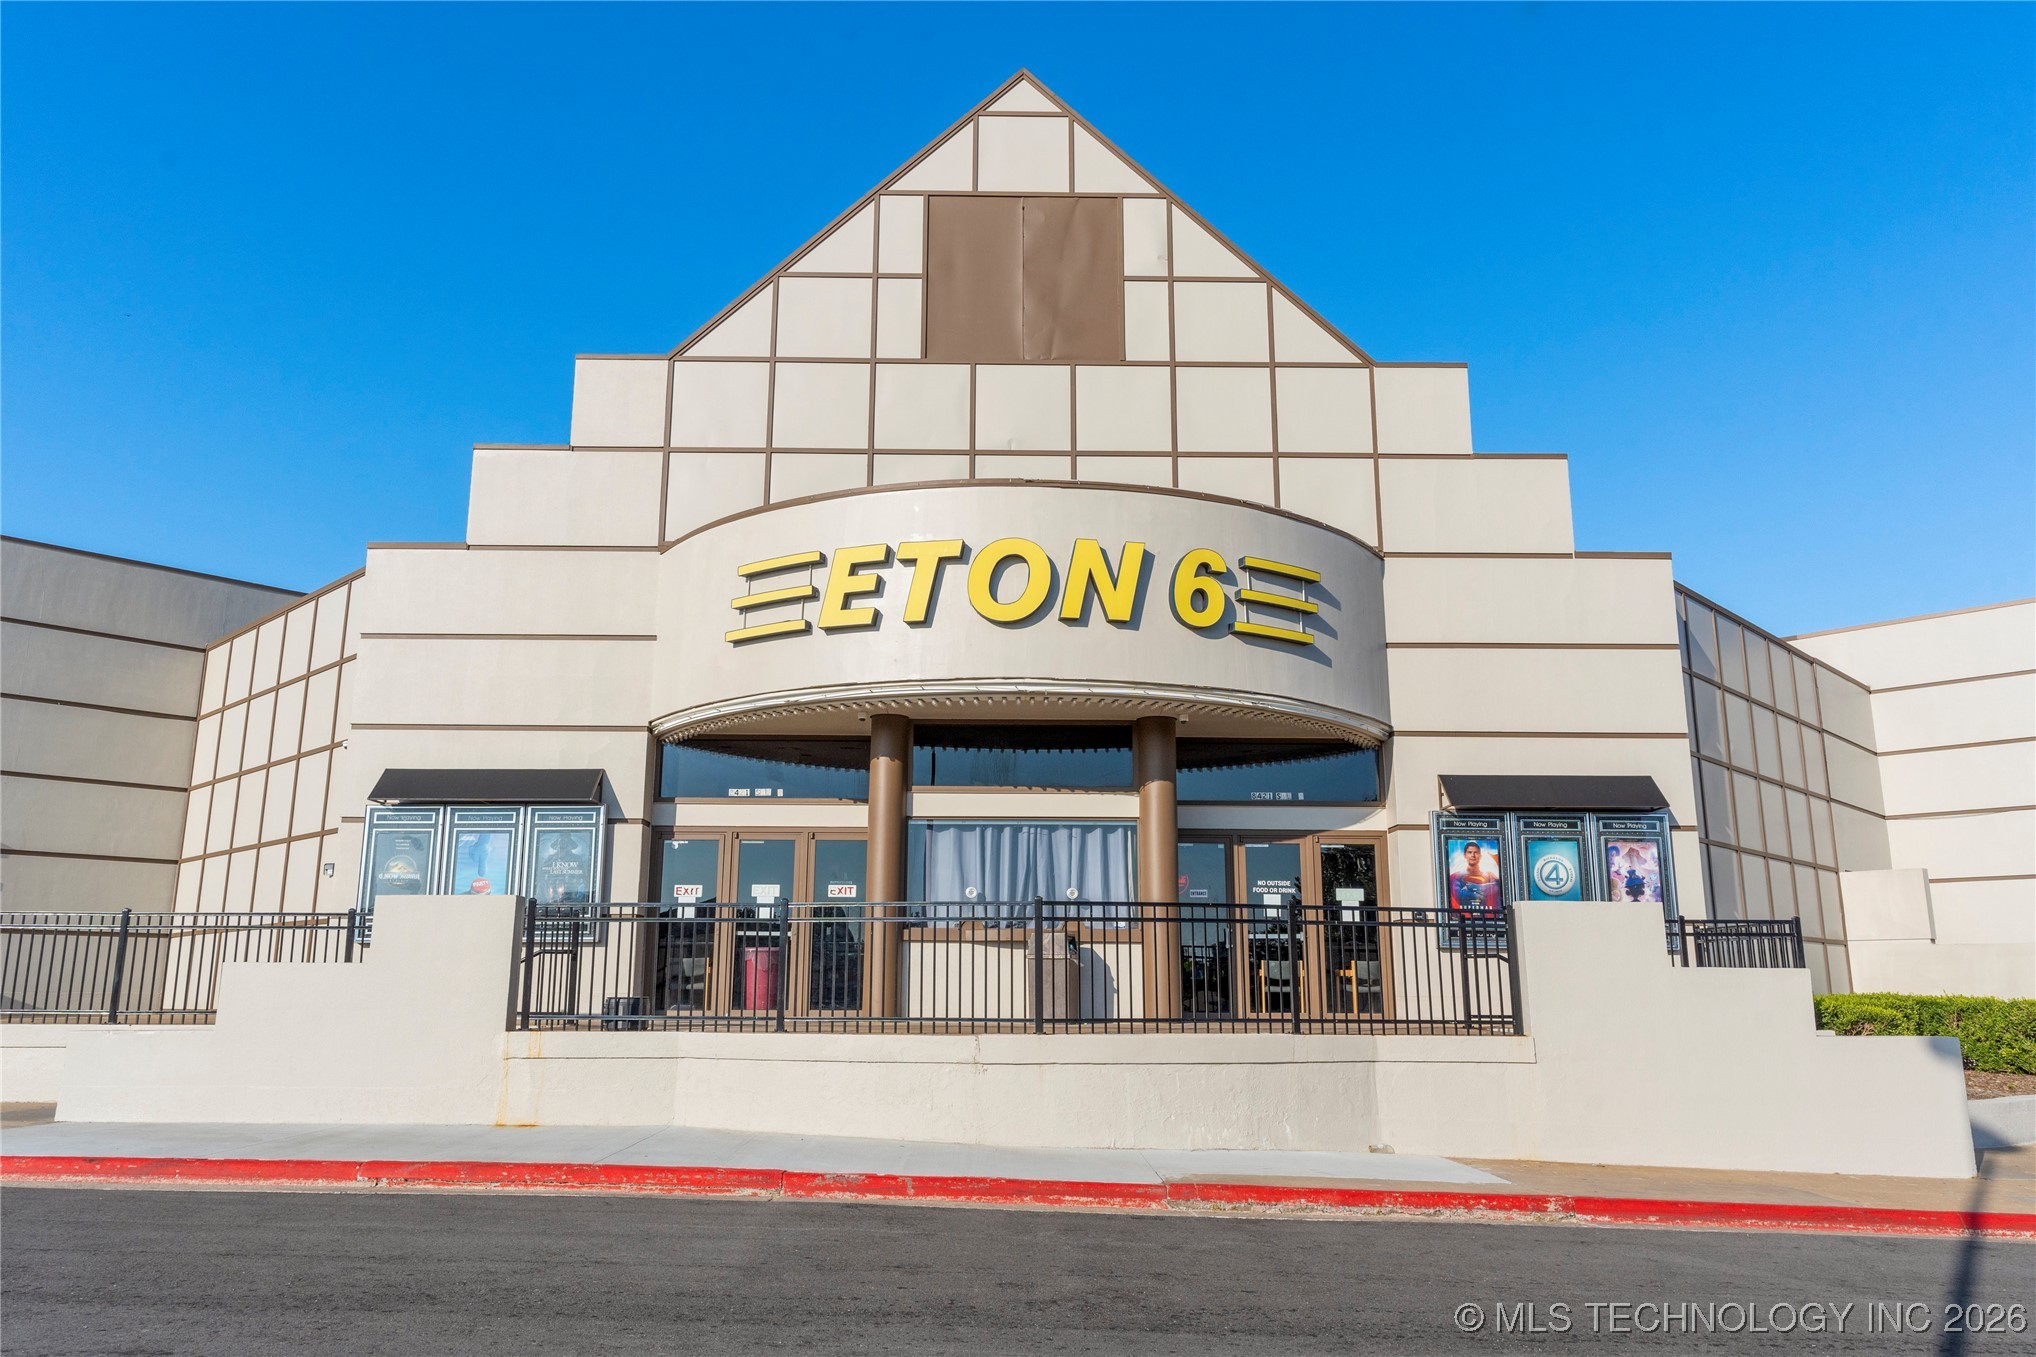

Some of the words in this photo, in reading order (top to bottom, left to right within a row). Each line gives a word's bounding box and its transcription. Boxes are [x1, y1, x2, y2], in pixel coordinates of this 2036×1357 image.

[817, 537, 1148, 631] ETON
[1173, 547, 1230, 630] 6
[730, 788, 749, 796] 41
[1251, 792, 1272, 800] 8421
[1545, 863, 1564, 885] 4
[830, 886, 854, 895] EXIT
